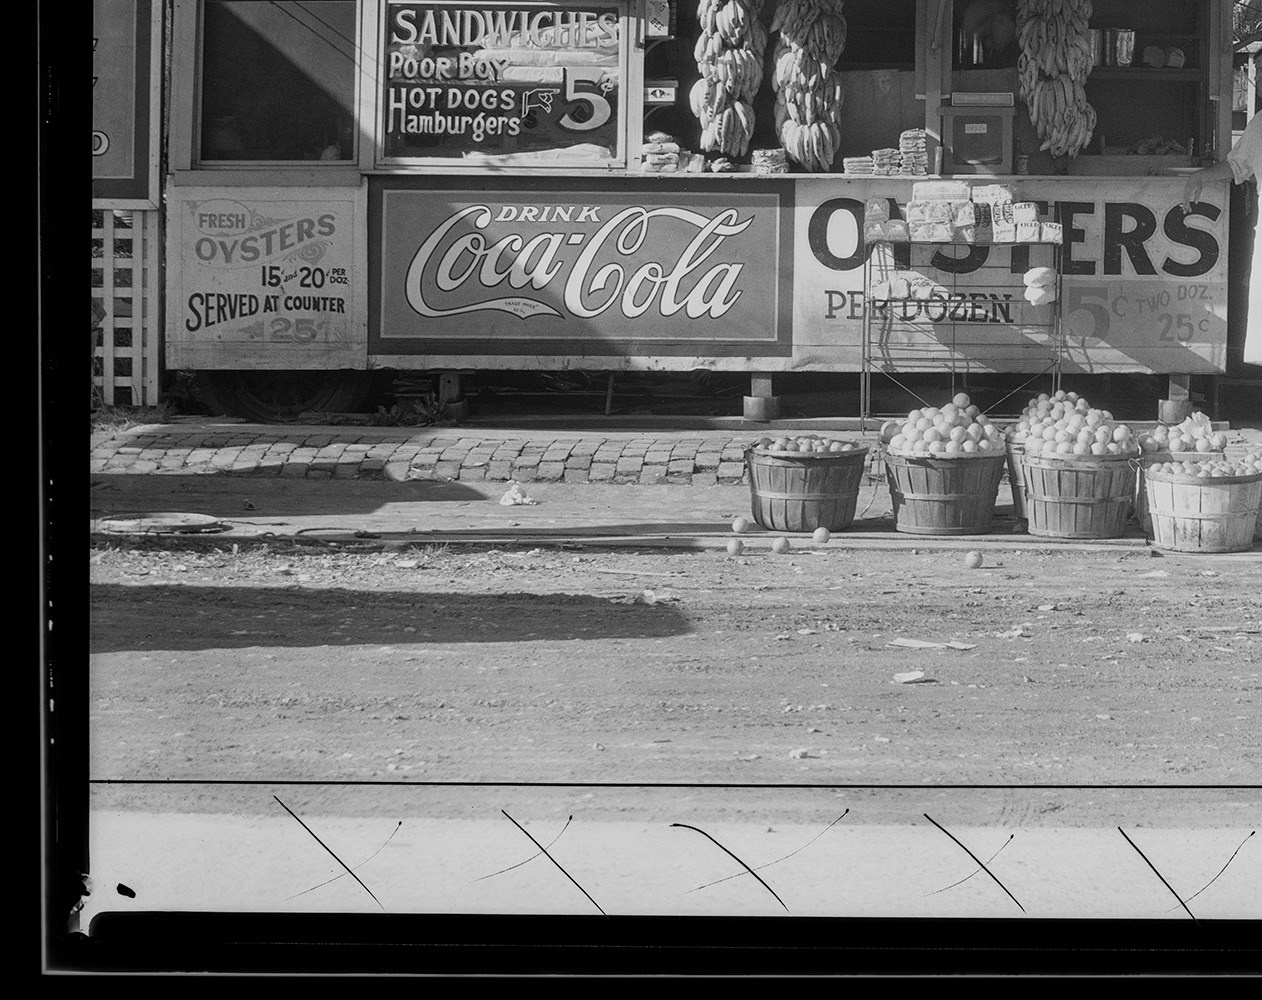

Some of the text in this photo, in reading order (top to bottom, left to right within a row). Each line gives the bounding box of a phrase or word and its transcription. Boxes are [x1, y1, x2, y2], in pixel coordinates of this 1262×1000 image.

[391, 9, 619, 48] SANDWICHES
[389, 87, 516, 115] HOT DOGS
[388, 105, 521, 142] Hamburgers
[199, 213, 246, 229] FRESH
[495, 206, 601, 222] DRINK
[195, 214, 336, 263] OYSTERS
[284, 270, 298, 282] and
[332, 268, 346, 276] PER
[405, 204, 755, 320] Coca-Cola
[185, 292, 345, 332] SERVED AT COUNTER
[825, 291, 1015, 324] PER DOZEN
[1137, 290, 1171, 313] TWO
[1177, 284, 1213, 301] DOZ.
